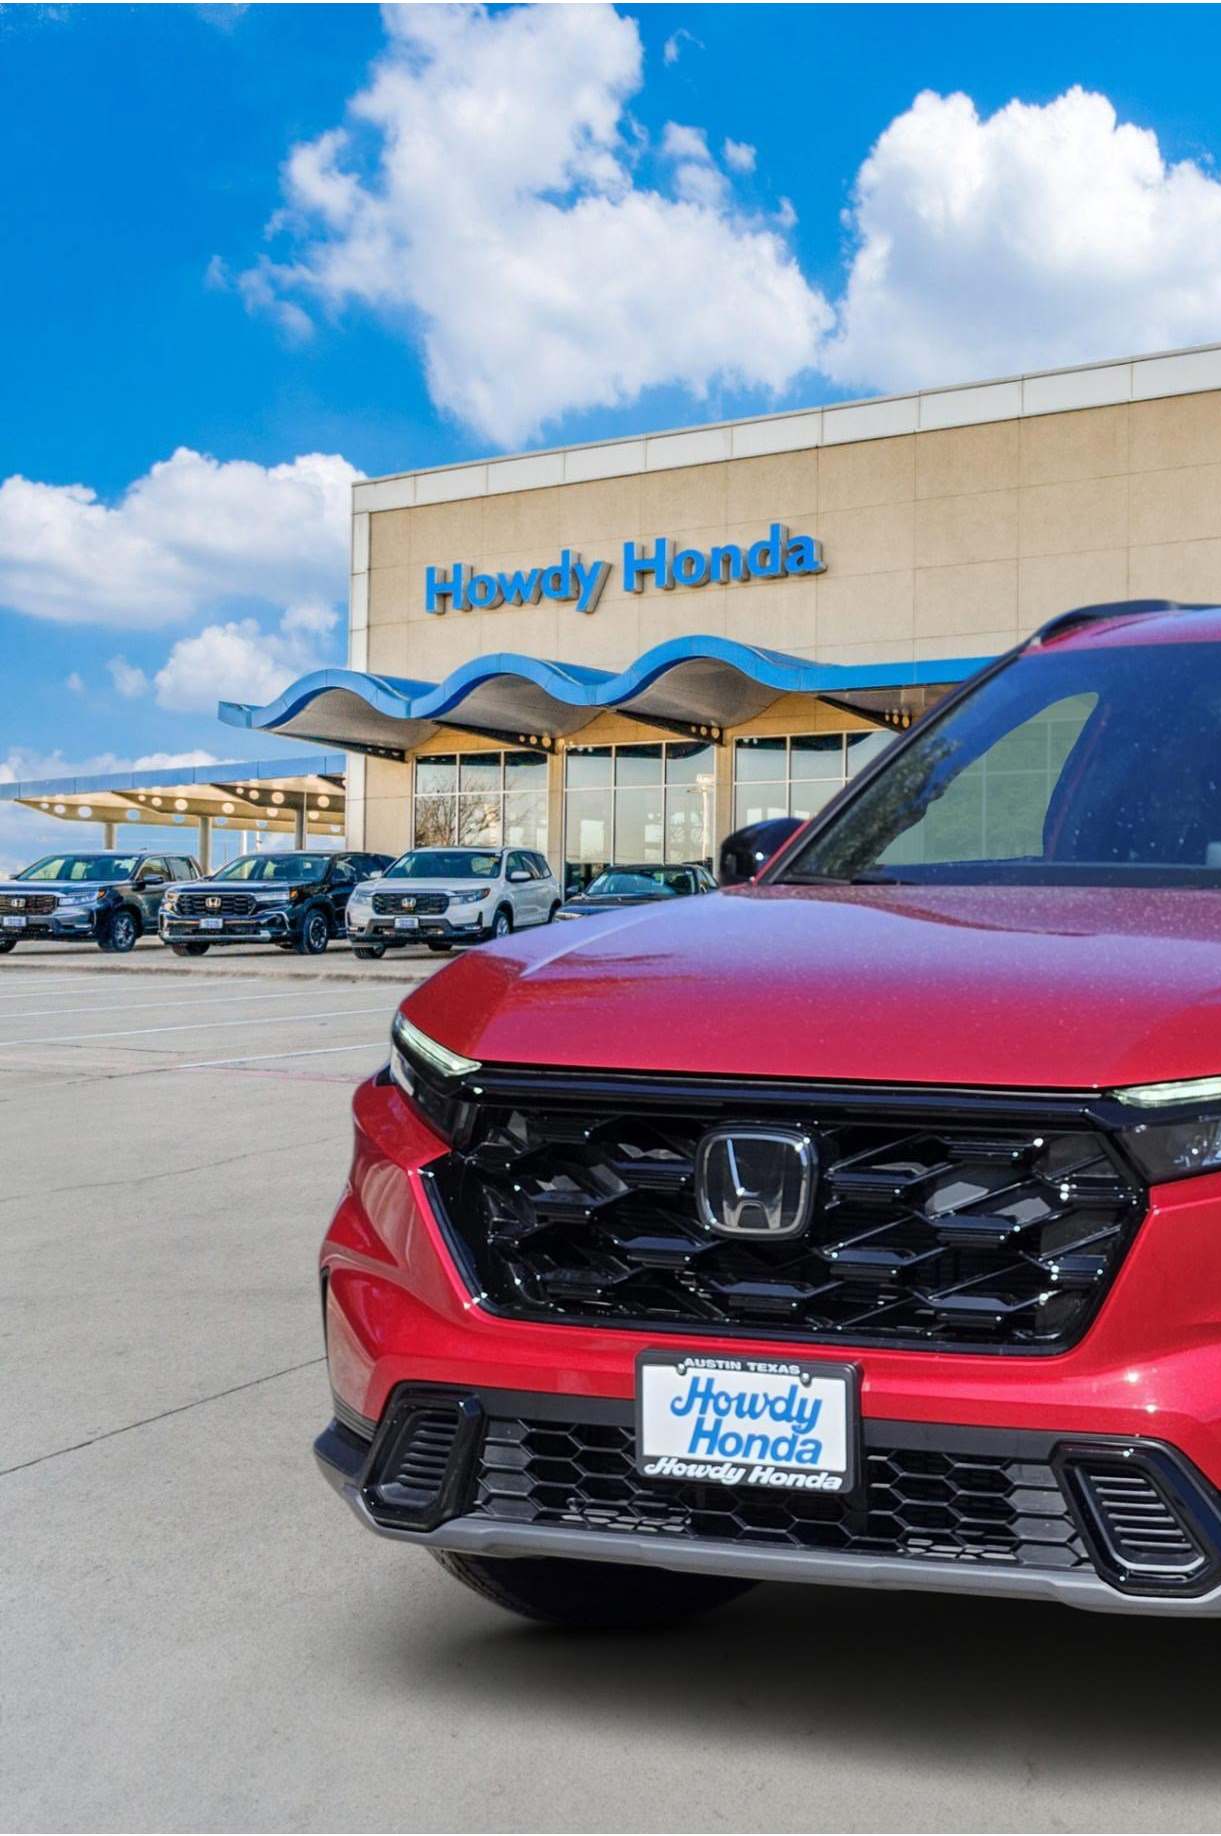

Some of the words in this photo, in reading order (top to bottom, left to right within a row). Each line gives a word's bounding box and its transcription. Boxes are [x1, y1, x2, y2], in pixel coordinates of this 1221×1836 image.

[425, 549, 612, 615] Howdy
[623, 523, 827, 593] Honda
[683, 1358, 741, 1370] AUSTIN
[747, 1362, 801, 1375] TEXAS
[670, 1376, 823, 1435] Howdy
[687, 1415, 823, 1465] Honda
[644, 1456, 746, 1485] Howdy
[747, 1465, 843, 1490] Honda
